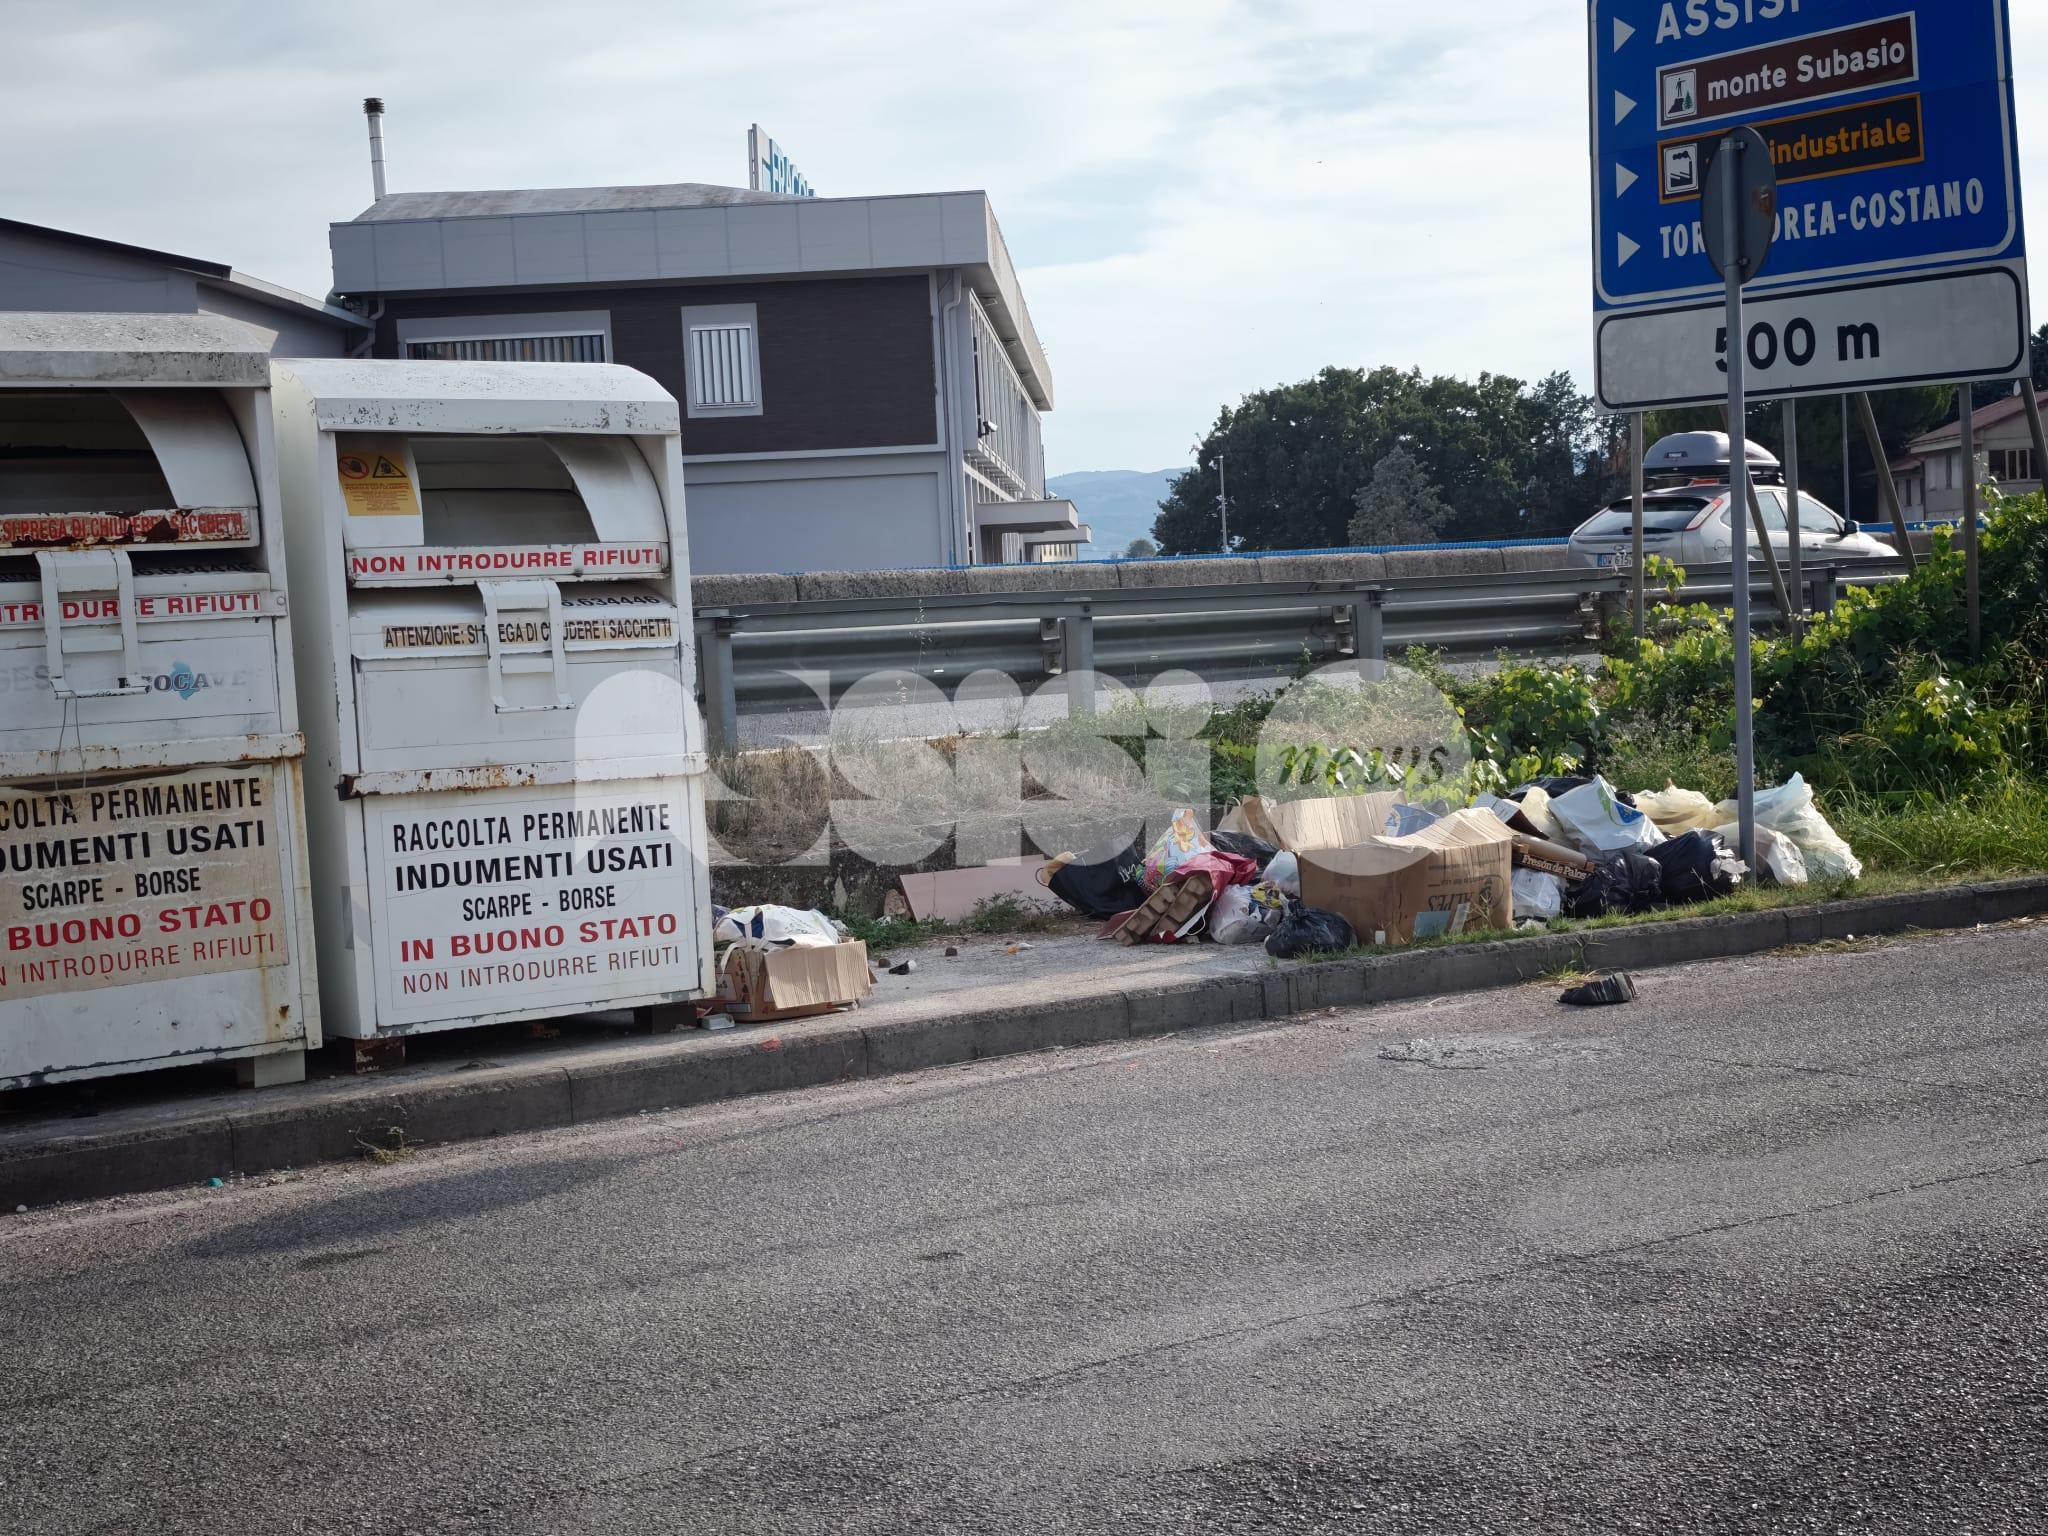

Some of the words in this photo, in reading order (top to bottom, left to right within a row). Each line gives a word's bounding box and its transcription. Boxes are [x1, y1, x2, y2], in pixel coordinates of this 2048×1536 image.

[1707, 64, 1787, 101] monte
[1796, 38, 1905, 82] Subasio
[1769, 118, 1911, 165] industriale
[1837, 322, 1880, 361] m
[351, 556, 406, 573] NON
[417, 552, 572, 571] INTRODURRE
[583, 548, 661, 567] RIFIUTI
[168, 593, 260, 614] RIFIUTI
[609, 618, 672, 638] SACCHETTI
[92, 778, 262, 822] PERMANENTE
[167, 820, 265, 856] USATI
[393, 816, 512, 852] RACCOLTA
[523, 803, 670, 842] PERMANENTE
[395, 851, 573, 891] INDUMENTI
[587, 842, 673, 874] USATI
[1563, 865, 1587, 880] Palos
[22, 878, 104, 911] SCARPE
[135, 867, 201, 898] BORSE
[462, 892, 532, 921] SCARPE
[559, 885, 616, 912] BORSE
[8, 914, 141, 951] BUONO
[159, 898, 272, 933] STATO
[400, 938, 434, 962] IN
[450, 925, 564, 957] BUONO
[579, 913, 677, 943] STATO
[21, 944, 181, 983] INTRODURRE
[193, 933, 275, 962] RIFIUTI
[403, 971, 449, 994] NON
[461, 954, 598, 988] INTRODURRE
[608, 946, 679, 971] RIFIUTI
